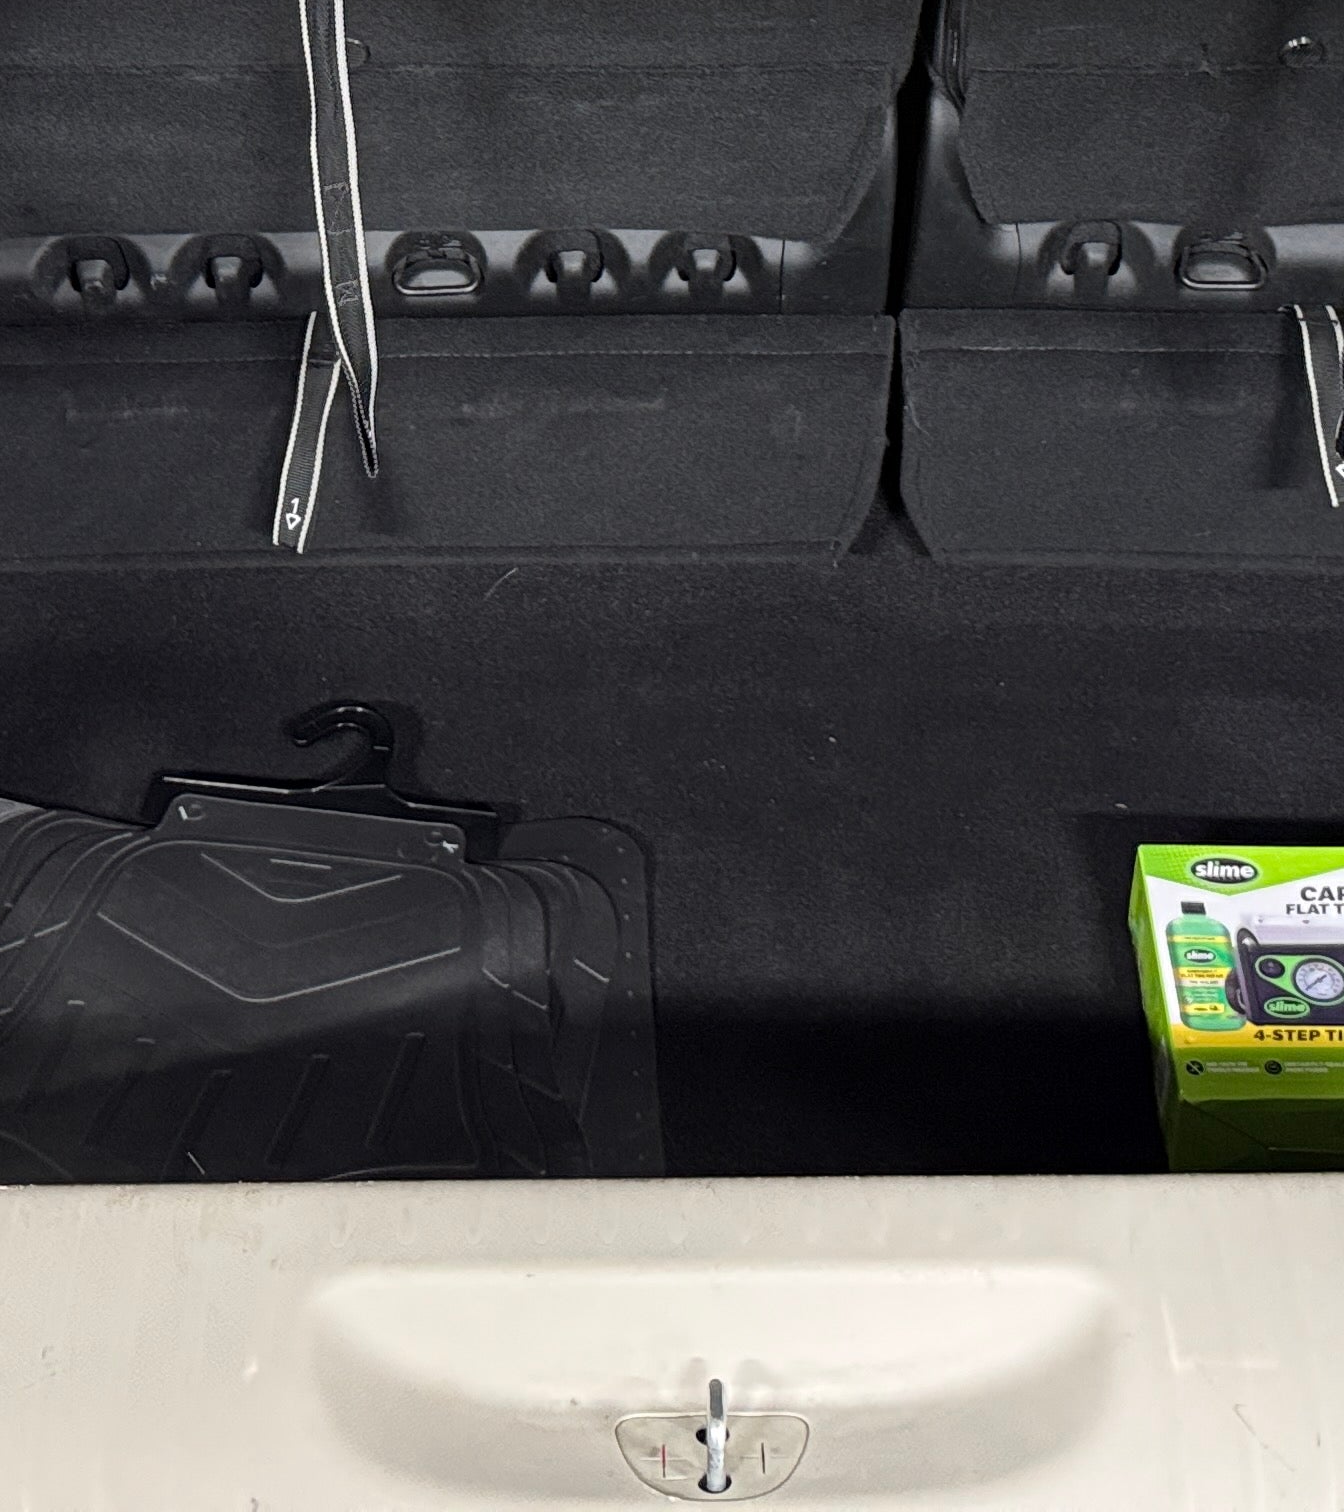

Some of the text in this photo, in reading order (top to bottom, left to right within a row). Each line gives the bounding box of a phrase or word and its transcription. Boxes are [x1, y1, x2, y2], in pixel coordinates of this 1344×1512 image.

[1195, 860, 1255, 880] slime
[1285, 903, 1330, 915] FLAT
[1268, 1001, 1306, 1012] slime
[1254, 1029, 1320, 1041] 4-STEP
